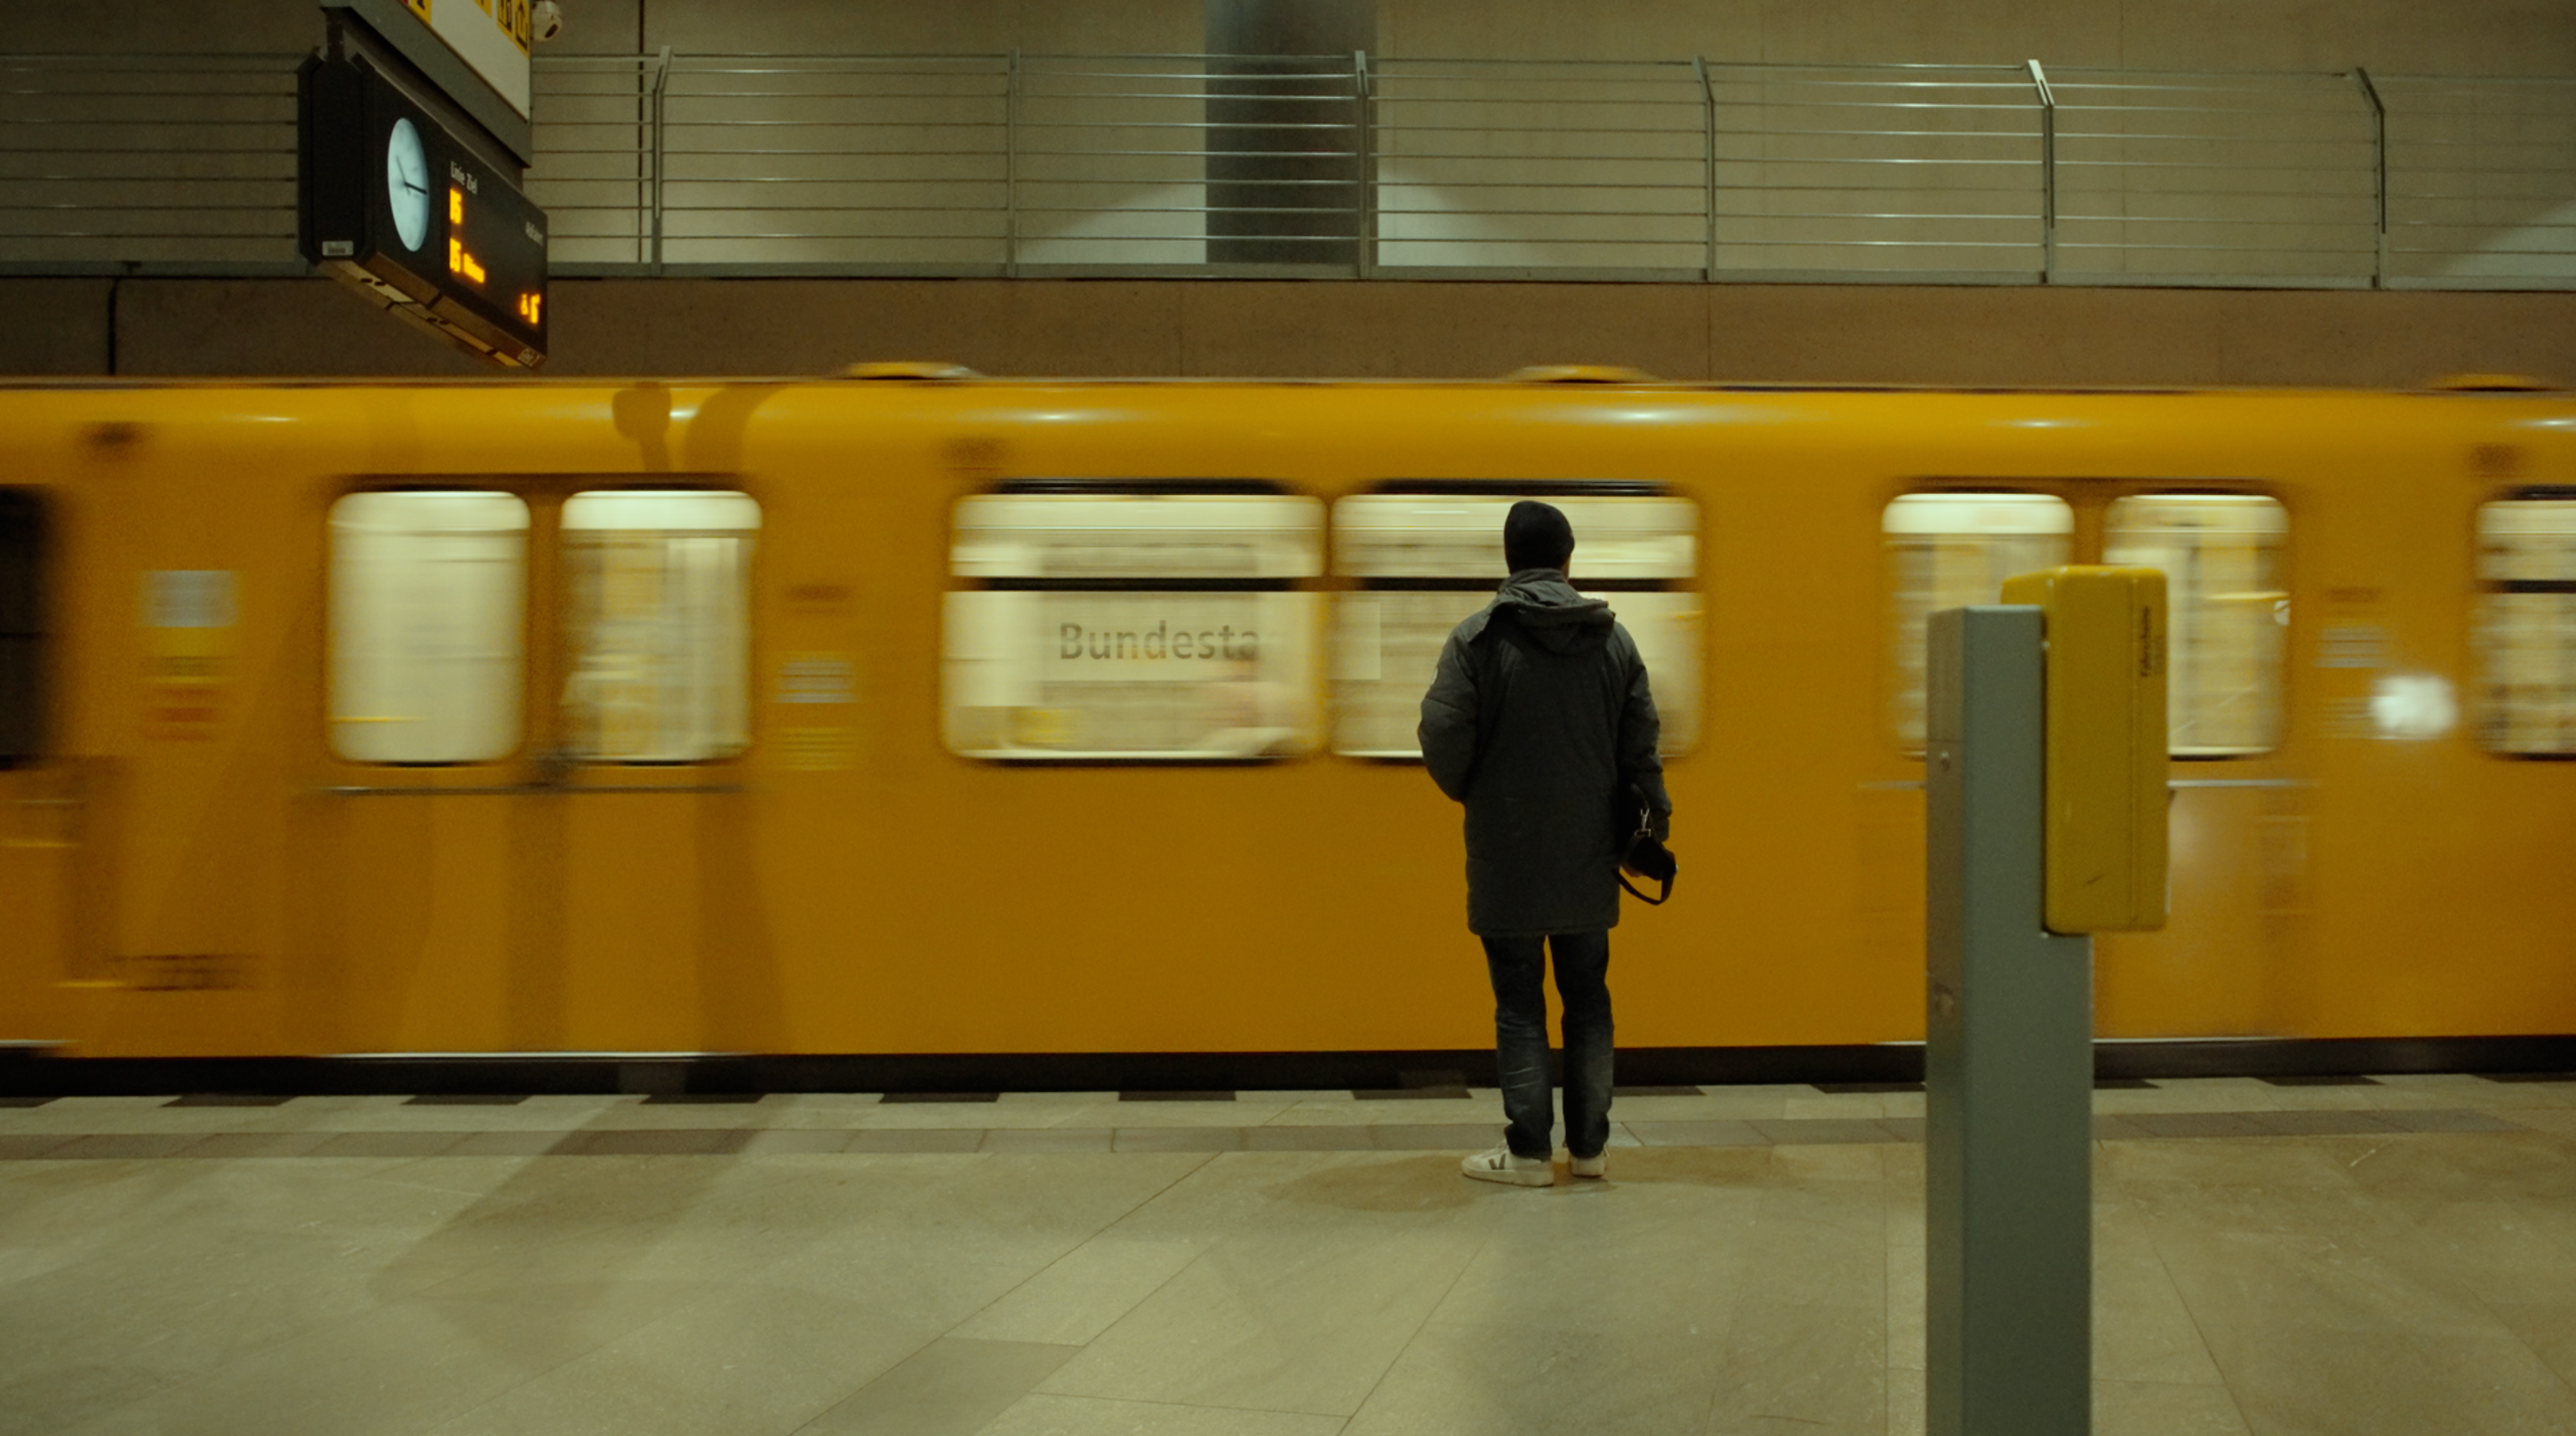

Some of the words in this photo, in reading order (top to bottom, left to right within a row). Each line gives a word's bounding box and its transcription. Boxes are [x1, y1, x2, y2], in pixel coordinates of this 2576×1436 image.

[450, 160, 466, 186] Linie
[466, 173, 478, 195] Ziel
[1060, 620, 1260, 660] Bundesta
